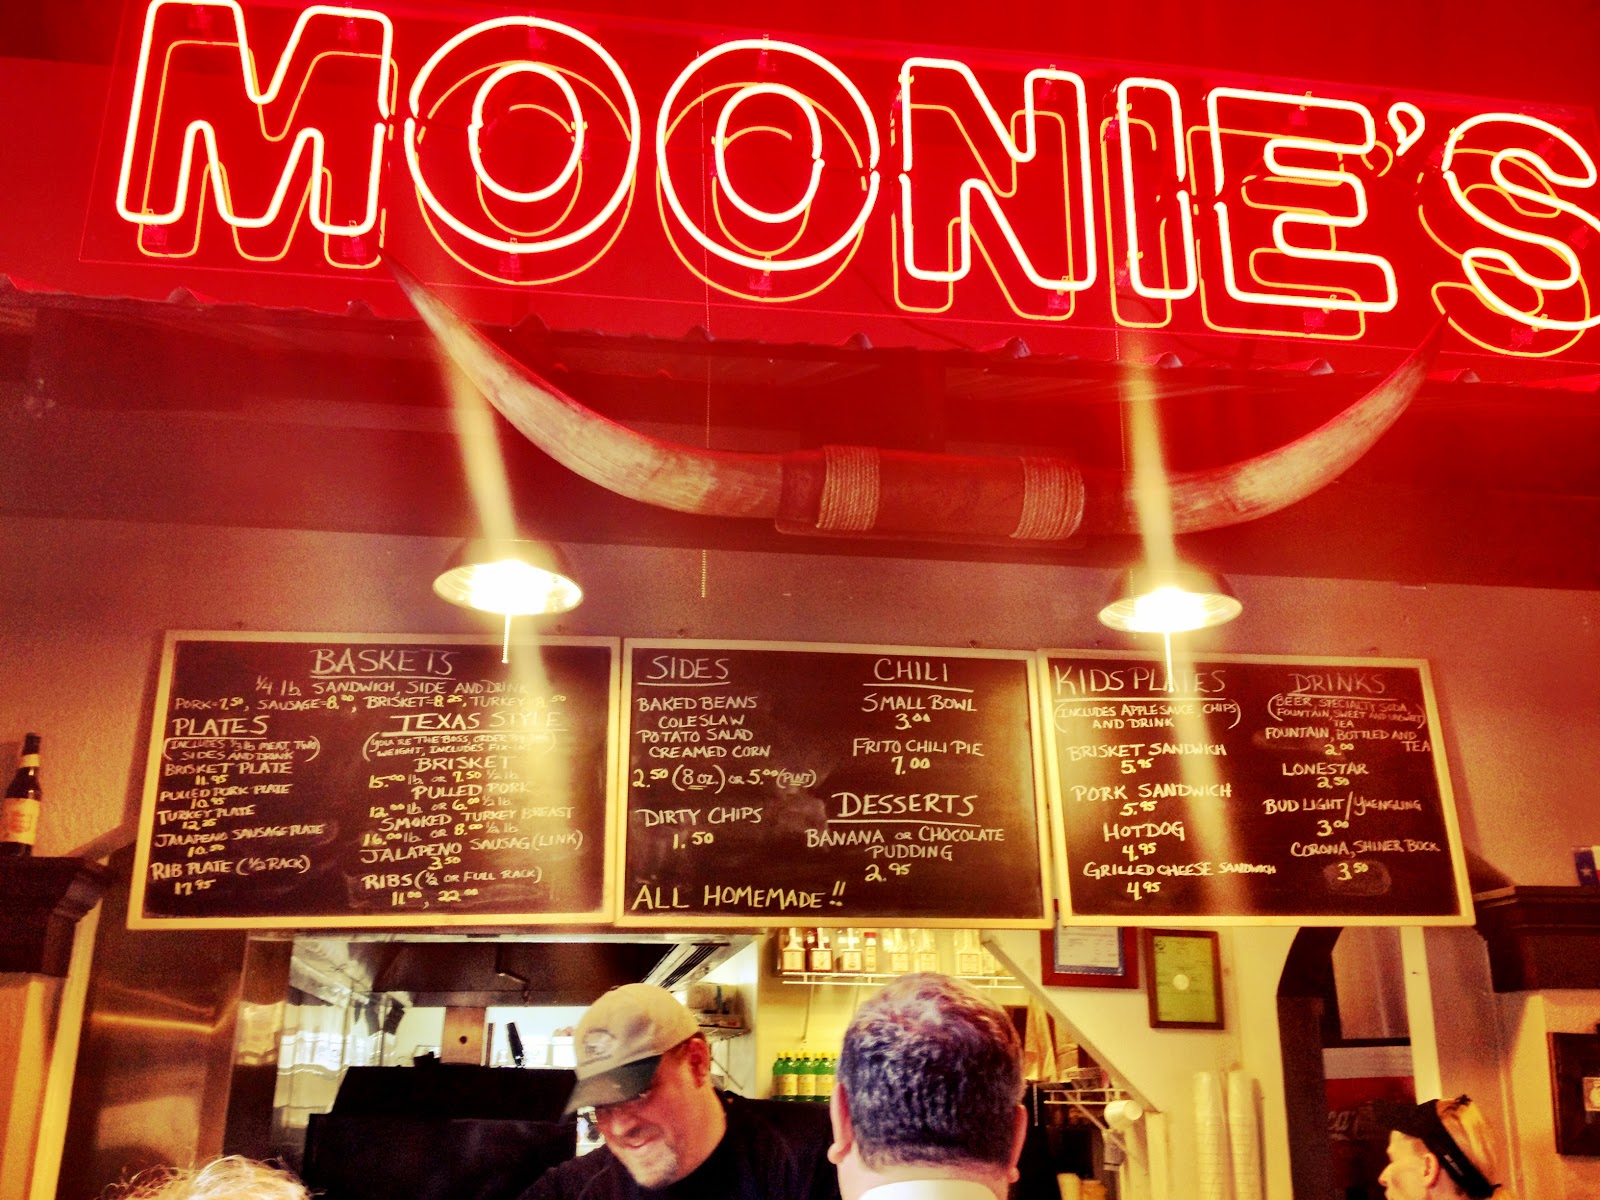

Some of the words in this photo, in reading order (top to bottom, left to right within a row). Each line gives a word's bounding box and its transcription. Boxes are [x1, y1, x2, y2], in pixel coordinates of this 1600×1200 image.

[115, 0, 1600, 332] MOONIE'S
[309, 647, 456, 675] BASKETS
[647, 656, 730, 679] SIDES
[874, 659, 949, 682] CHILI
[405, 681, 447, 694] SIDE
[454, 682, 483, 694] AND
[1054, 665, 1125, 695] KIDS
[1288, 672, 1385, 693] DRINKS
[637, 696, 697, 712] BAKED
[699, 696, 758, 710] BEANS
[861, 693, 926, 712] SMALL
[928, 695, 977, 712] BOWL
[172, 715, 270, 736] PLATES
[390, 712, 481, 731] TEXAS
[489, 711, 562, 728] STYLE
[1092, 718, 1124, 729] AND
[1126, 718, 1174, 728] DRINK
[1333, 719, 1355, 727] TEA
[414, 736, 439, 744] THE
[636, 729, 700, 743] POTATO
[706, 728, 753, 741] SALAD
[1335, 729, 1389, 741] BOTTLED
[1391, 731, 1417, 740] AND
[429, 745, 483, 754] INCLUDES
[649, 746, 727, 758] CREAMED
[732, 745, 771, 758] CORN
[853, 737, 902, 757] FRITO
[905, 739, 947, 753] CHILI
[950, 740, 985, 757] PIE
[1066, 743, 1145, 761] BRISKET
[1148, 742, 1227, 756] SANDWICH
[1400, 740, 1430, 752] TEA
[180, 751, 225, 761] SIDES
[227, 752, 255, 760] AND
[256, 752, 293, 760] DRINK
[413, 756, 518, 773] BRISKET
[165, 763, 235, 776] BRISKET
[238, 762, 293, 774] PLATE
[1282, 762, 1370, 776] LONESTAR
[728, 776, 744, 785] OR
[160, 790, 210, 802] PULLED
[213, 787, 249, 797] PORK
[251, 783, 293, 795] PLATE
[411, 785, 482, 800] PULLED
[486, 781, 532, 794] PORK
[1070, 784, 1129, 801] PORK
[1138, 783, 1233, 799] SANDWICH
[432, 803, 447, 811] OR
[831, 792, 978, 817] DESSERTS
[1262, 798, 1299, 815] BUD
[157, 810, 215, 825] TURKEY
[215, 805, 256, 818] PLATE
[378, 815, 452, 832] SMOKED
[461, 810, 516, 821] TURKEY
[521, 806, 576, 819] BREAST
[635, 808, 702, 827] DIRTY
[708, 807, 763, 824] CHIPS
[154, 834, 228, 847] JALAPENO
[289, 823, 326, 836] PLATE
[430, 829, 448, 838] OR
[805, 828, 885, 847] BANANA
[894, 832, 913, 840] OR
[918, 826, 1005, 842] CHOCOLATE
[1103, 821, 1185, 842] HOTDOG
[359, 843, 462, 864] JALAPENO
[864, 845, 953, 861] PUDDING
[1352, 839, 1404, 853] SHINER
[1403, 838, 1441, 852] BOCK
[151, 862, 182, 880] RIB
[186, 860, 233, 875] PLATE
[1083, 861, 1155, 880] GRILLED
[1156, 862, 1214, 876] CHEESE
[1218, 862, 1277, 875] SANDWICH
[361, 873, 412, 890] RIBS
[443, 874, 460, 883] OR
[464, 871, 496, 882] FULL
[631, 884, 690, 911] ALL
